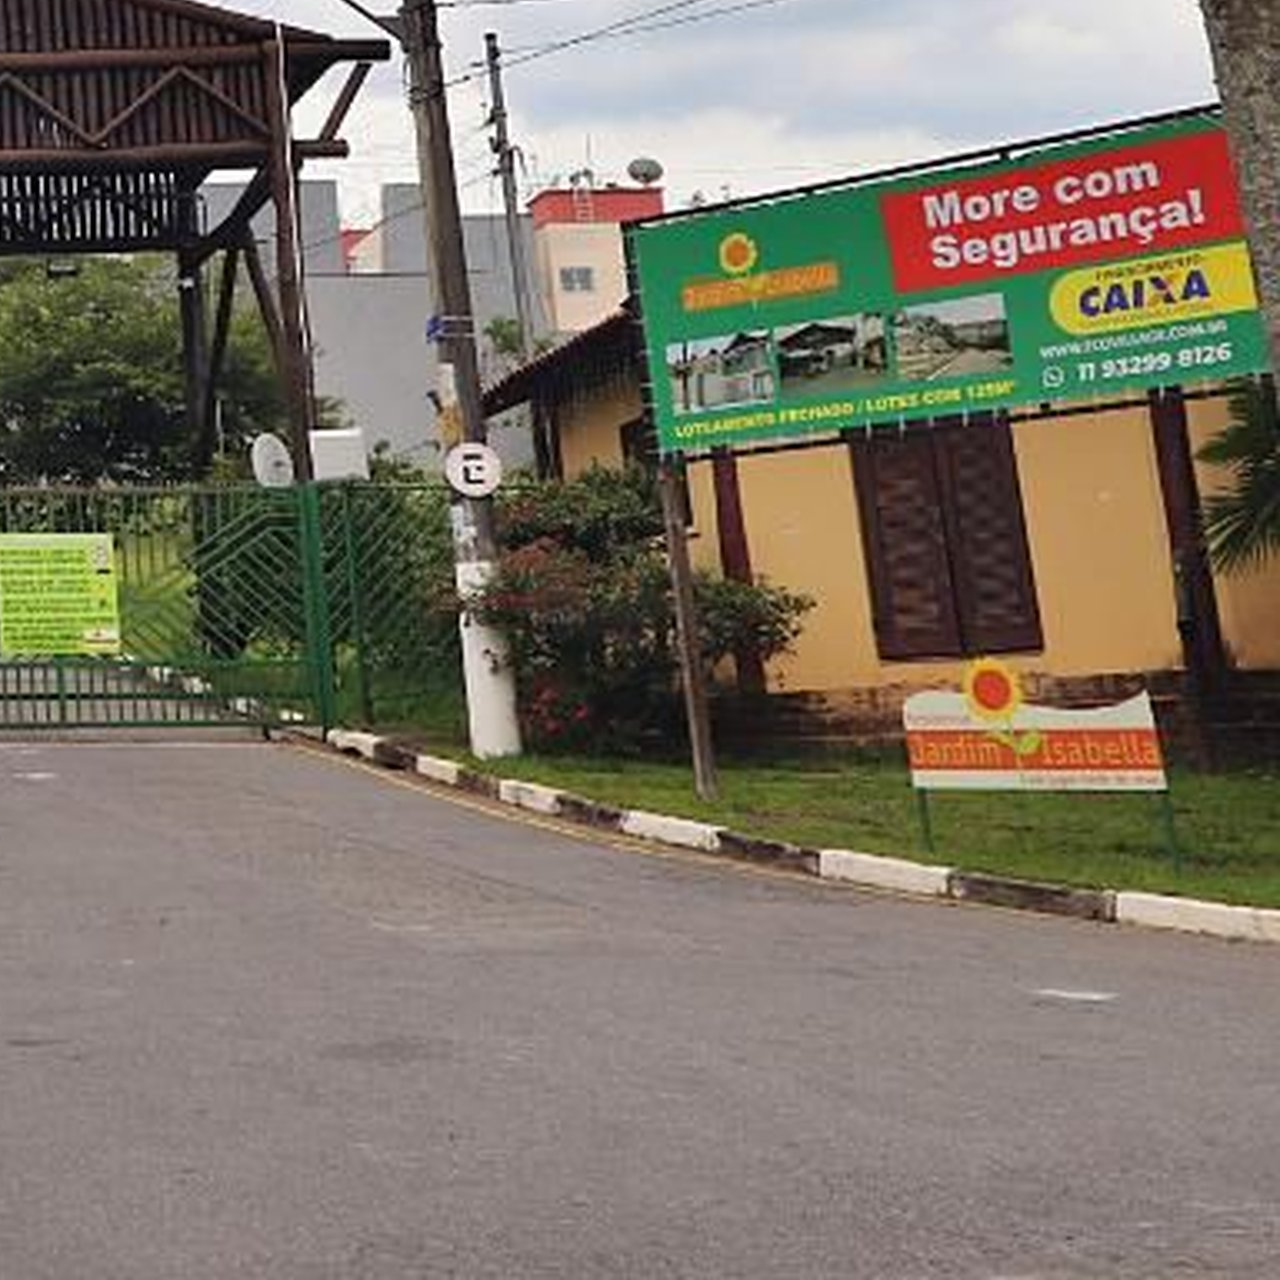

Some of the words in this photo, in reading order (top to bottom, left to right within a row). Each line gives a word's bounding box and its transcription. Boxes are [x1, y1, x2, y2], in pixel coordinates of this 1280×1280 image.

[922, 185, 1039, 228] More
[1054, 162, 1159, 204] com
[930, 189, 1205, 269] Segurança!
[1079, 269, 1211, 318] CAIXA
[1077, 363, 1096, 382] 11
[1178, 342, 1232, 368] 8126
[910, 734, 1000, 764] Jardim
[1041, 732, 1160, 765] Isabella
